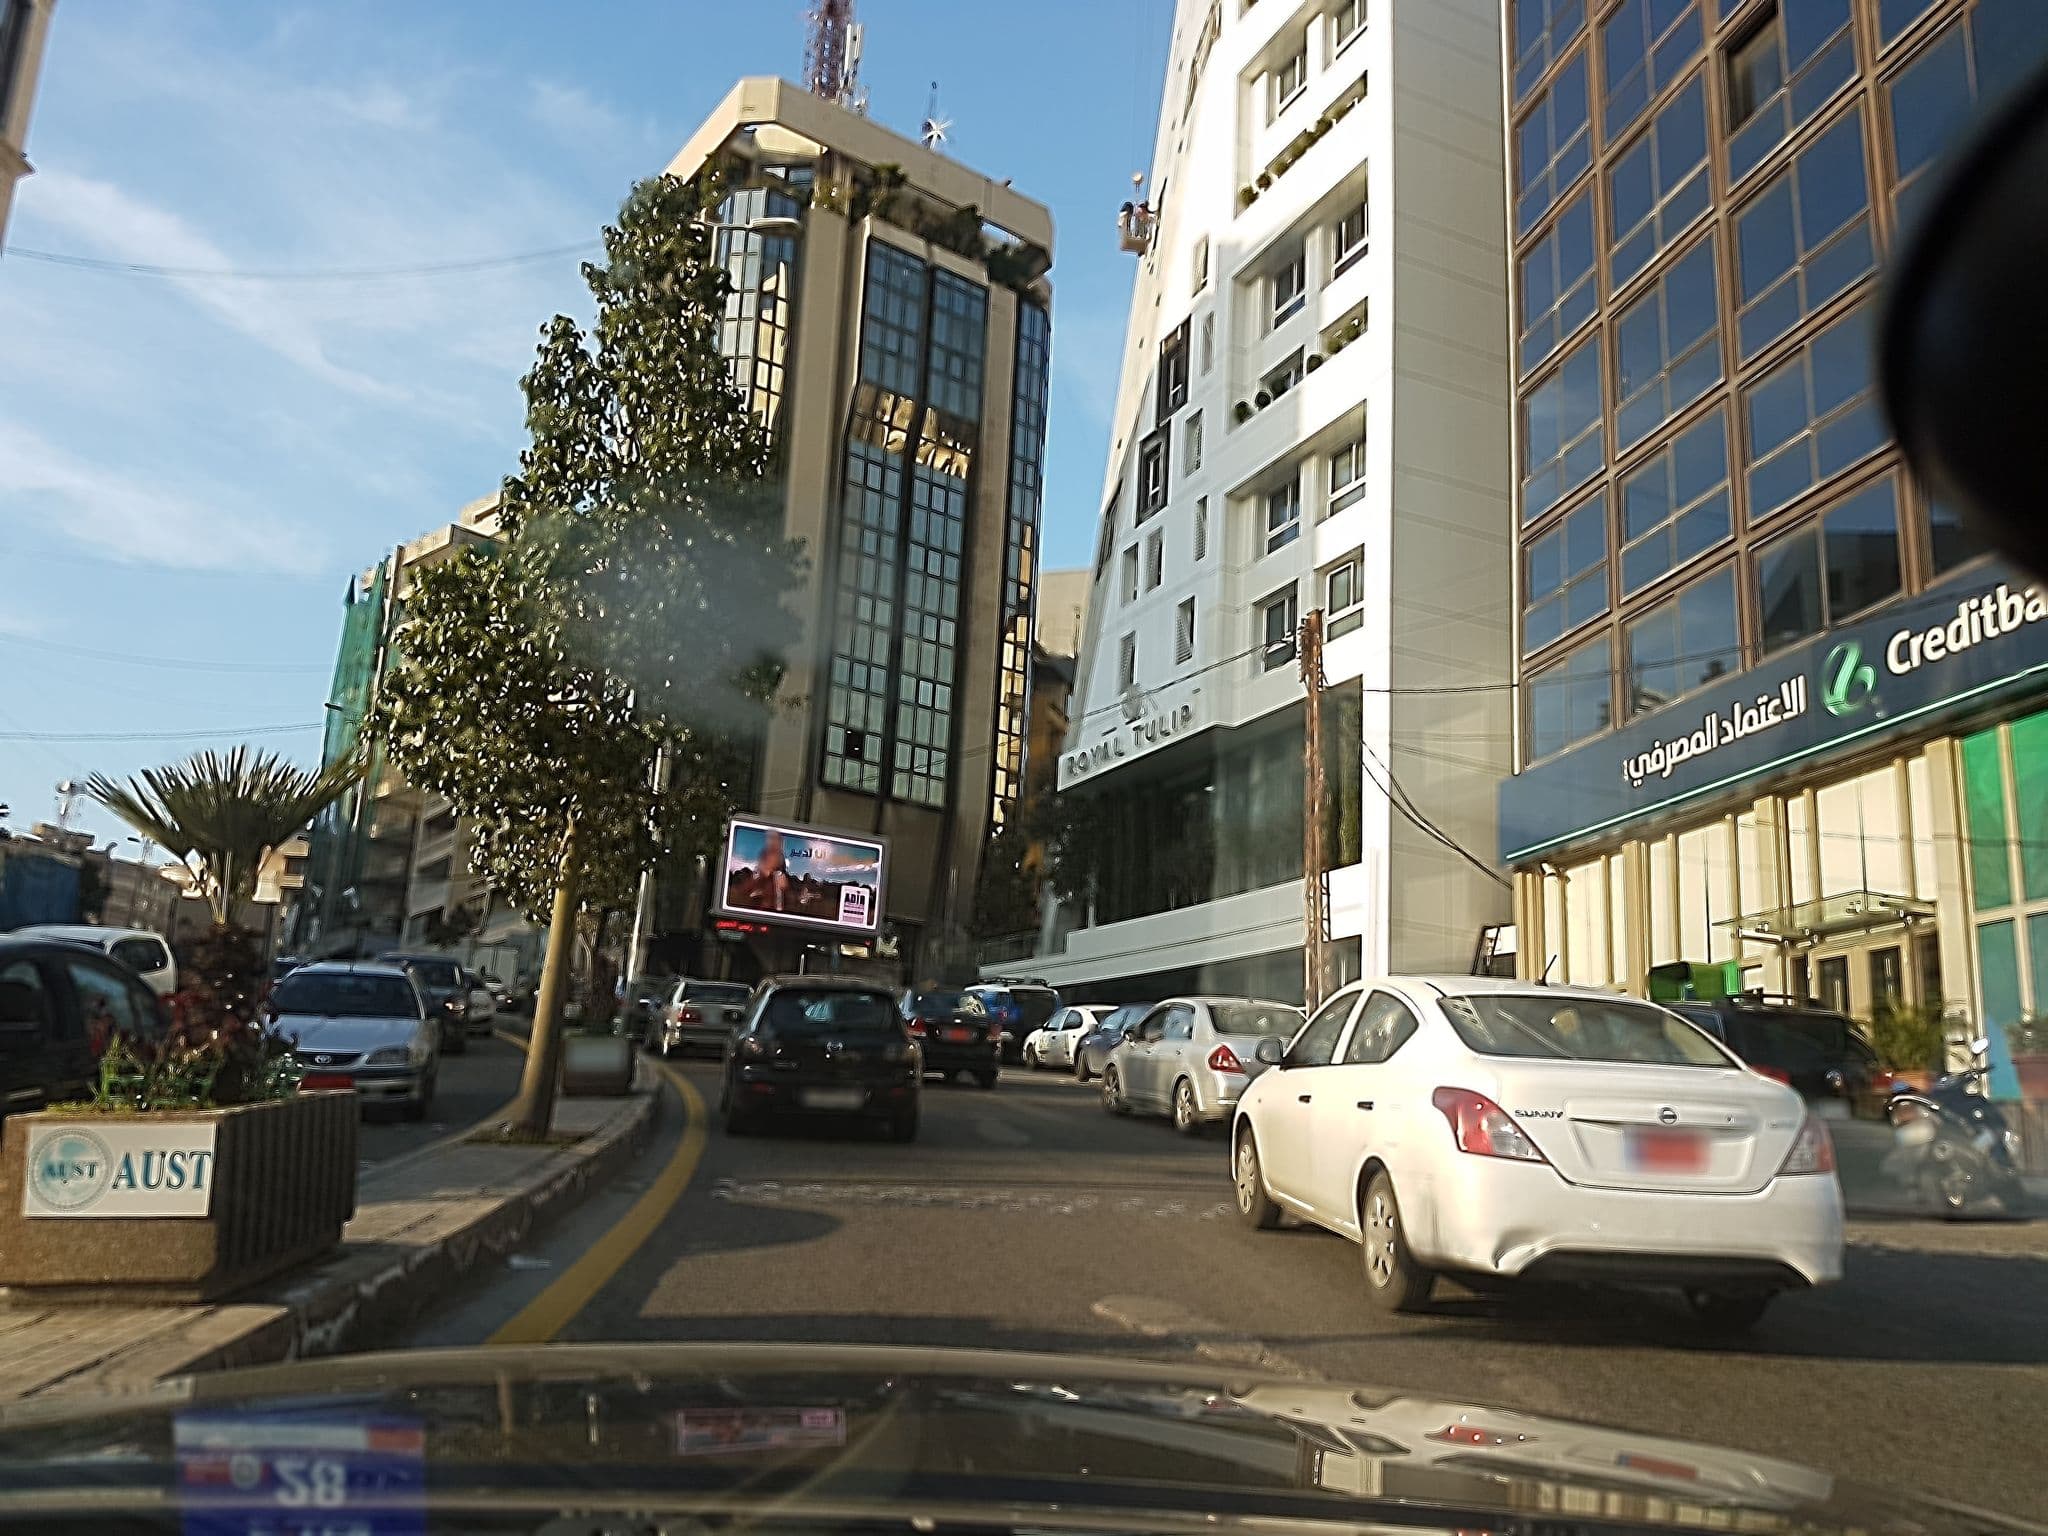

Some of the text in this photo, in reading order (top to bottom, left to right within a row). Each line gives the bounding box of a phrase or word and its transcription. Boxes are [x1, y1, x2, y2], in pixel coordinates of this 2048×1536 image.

[1132, 704, 1193, 747] TULIP
[1629, 674, 1808, 788] الاعتماد المصرفي
[1514, 1109, 1564, 1119] SUNNY
[42, 1161, 99, 1180] AUST
[113, 1150, 212, 1190] AUST
